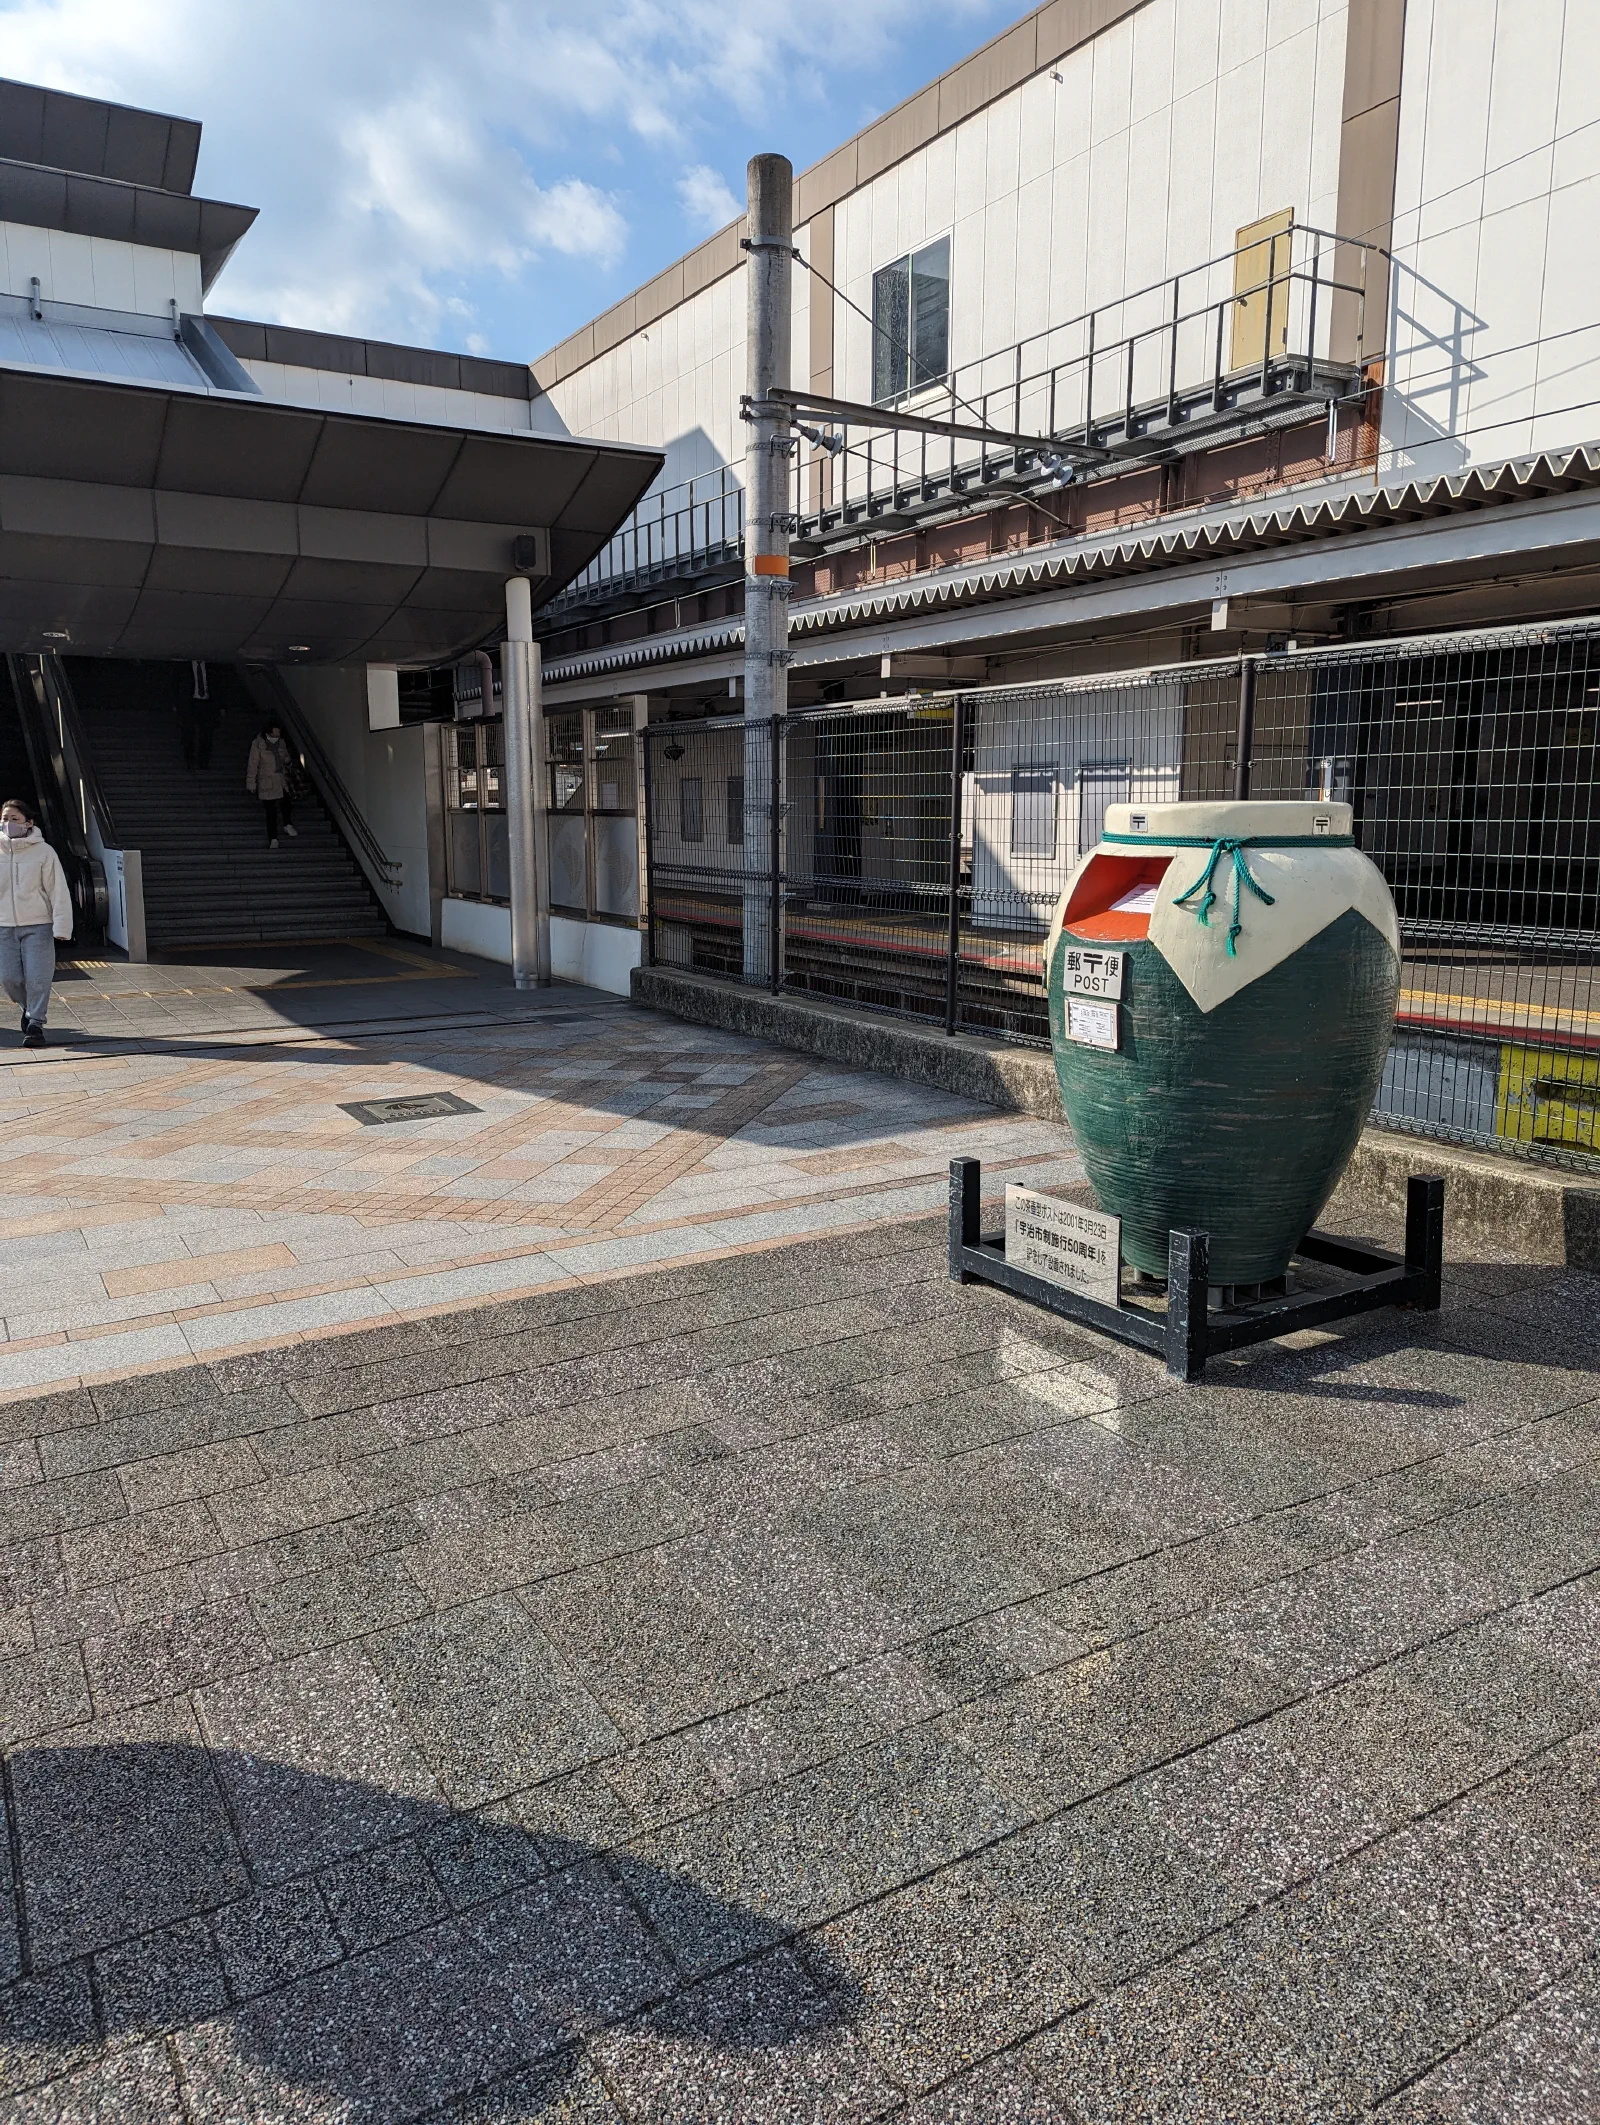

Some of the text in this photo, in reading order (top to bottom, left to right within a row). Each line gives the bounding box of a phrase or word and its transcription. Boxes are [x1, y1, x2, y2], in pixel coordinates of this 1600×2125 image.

[1074, 974, 1110, 993] POST
[1014, 1218, 1107, 1266] 「宇治市制施行50周年」を
[1026, 1246, 1090, 1285] 記念して設置されました。
